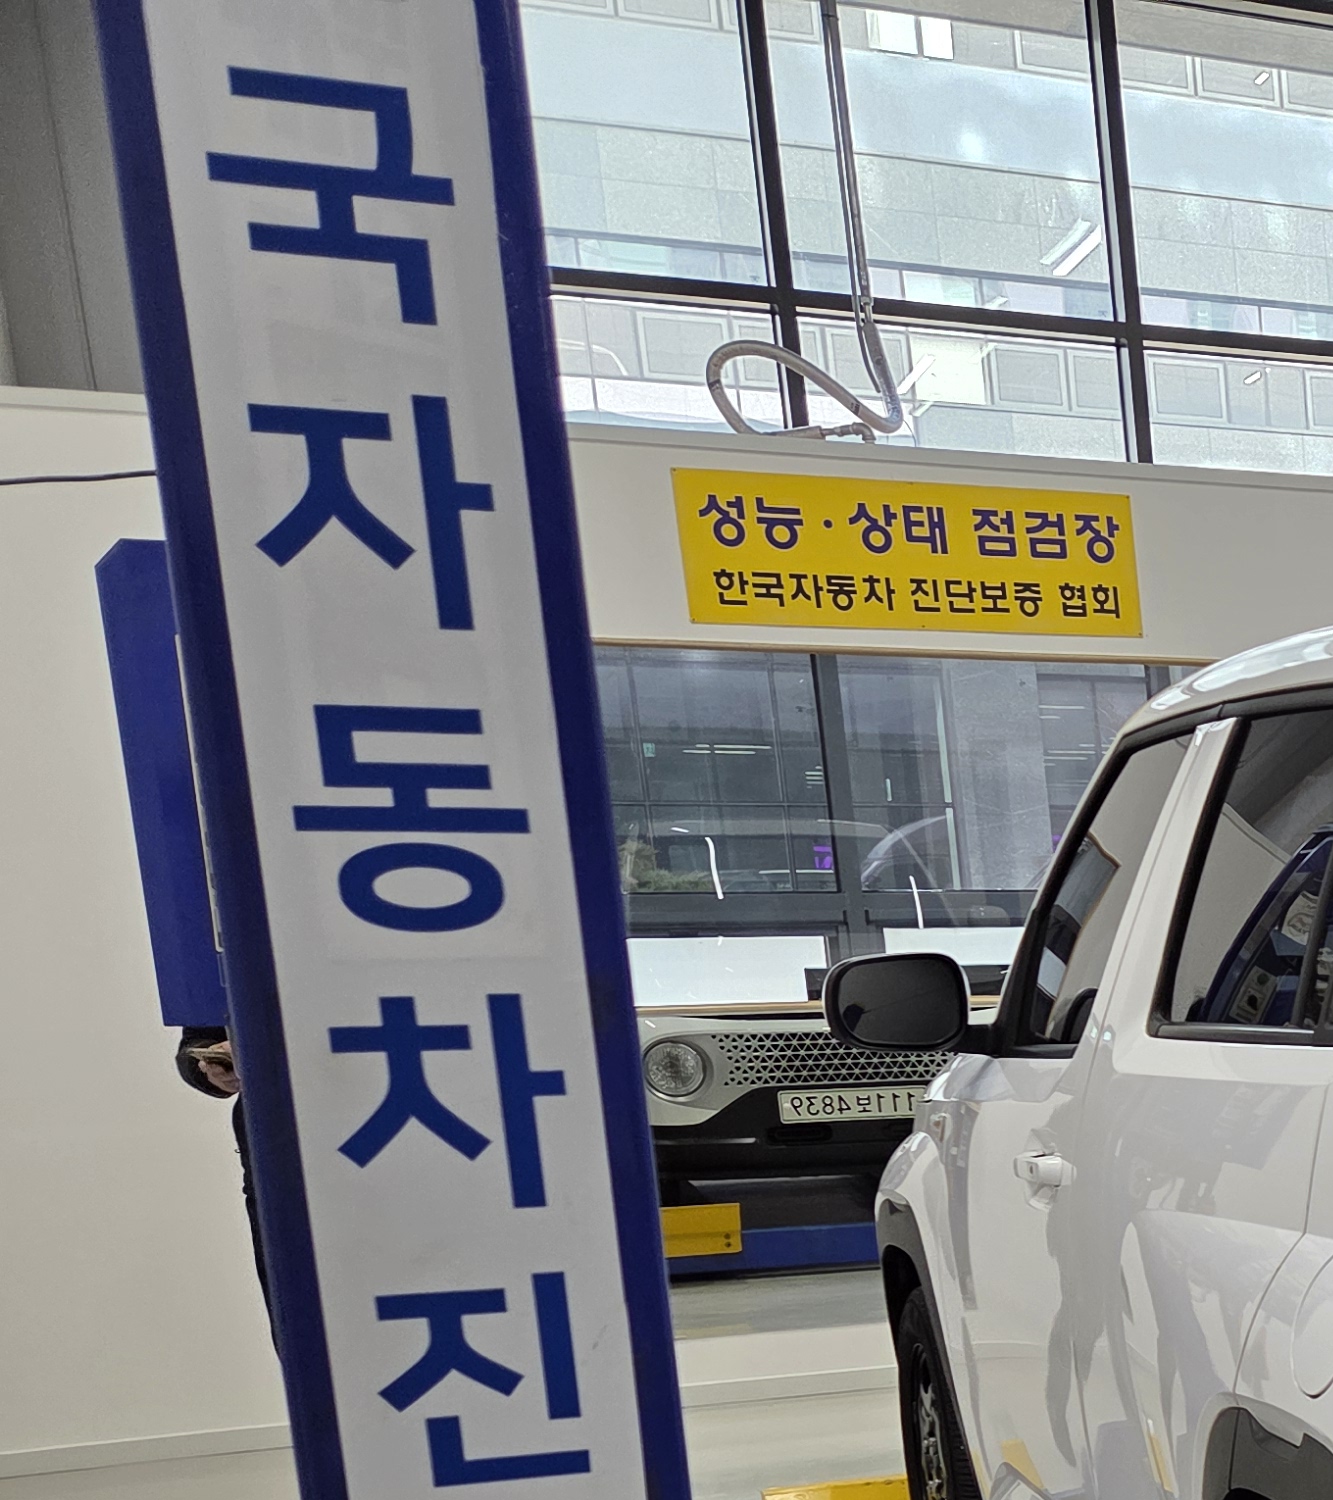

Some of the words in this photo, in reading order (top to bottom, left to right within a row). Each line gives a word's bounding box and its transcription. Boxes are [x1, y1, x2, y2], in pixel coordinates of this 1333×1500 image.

[971, 507, 1120, 564] 점검장
[712, 568, 896, 612] 한국자동차
[908, 576, 1043, 617] 진단보증
[1057, 581, 1122, 619] 협회
